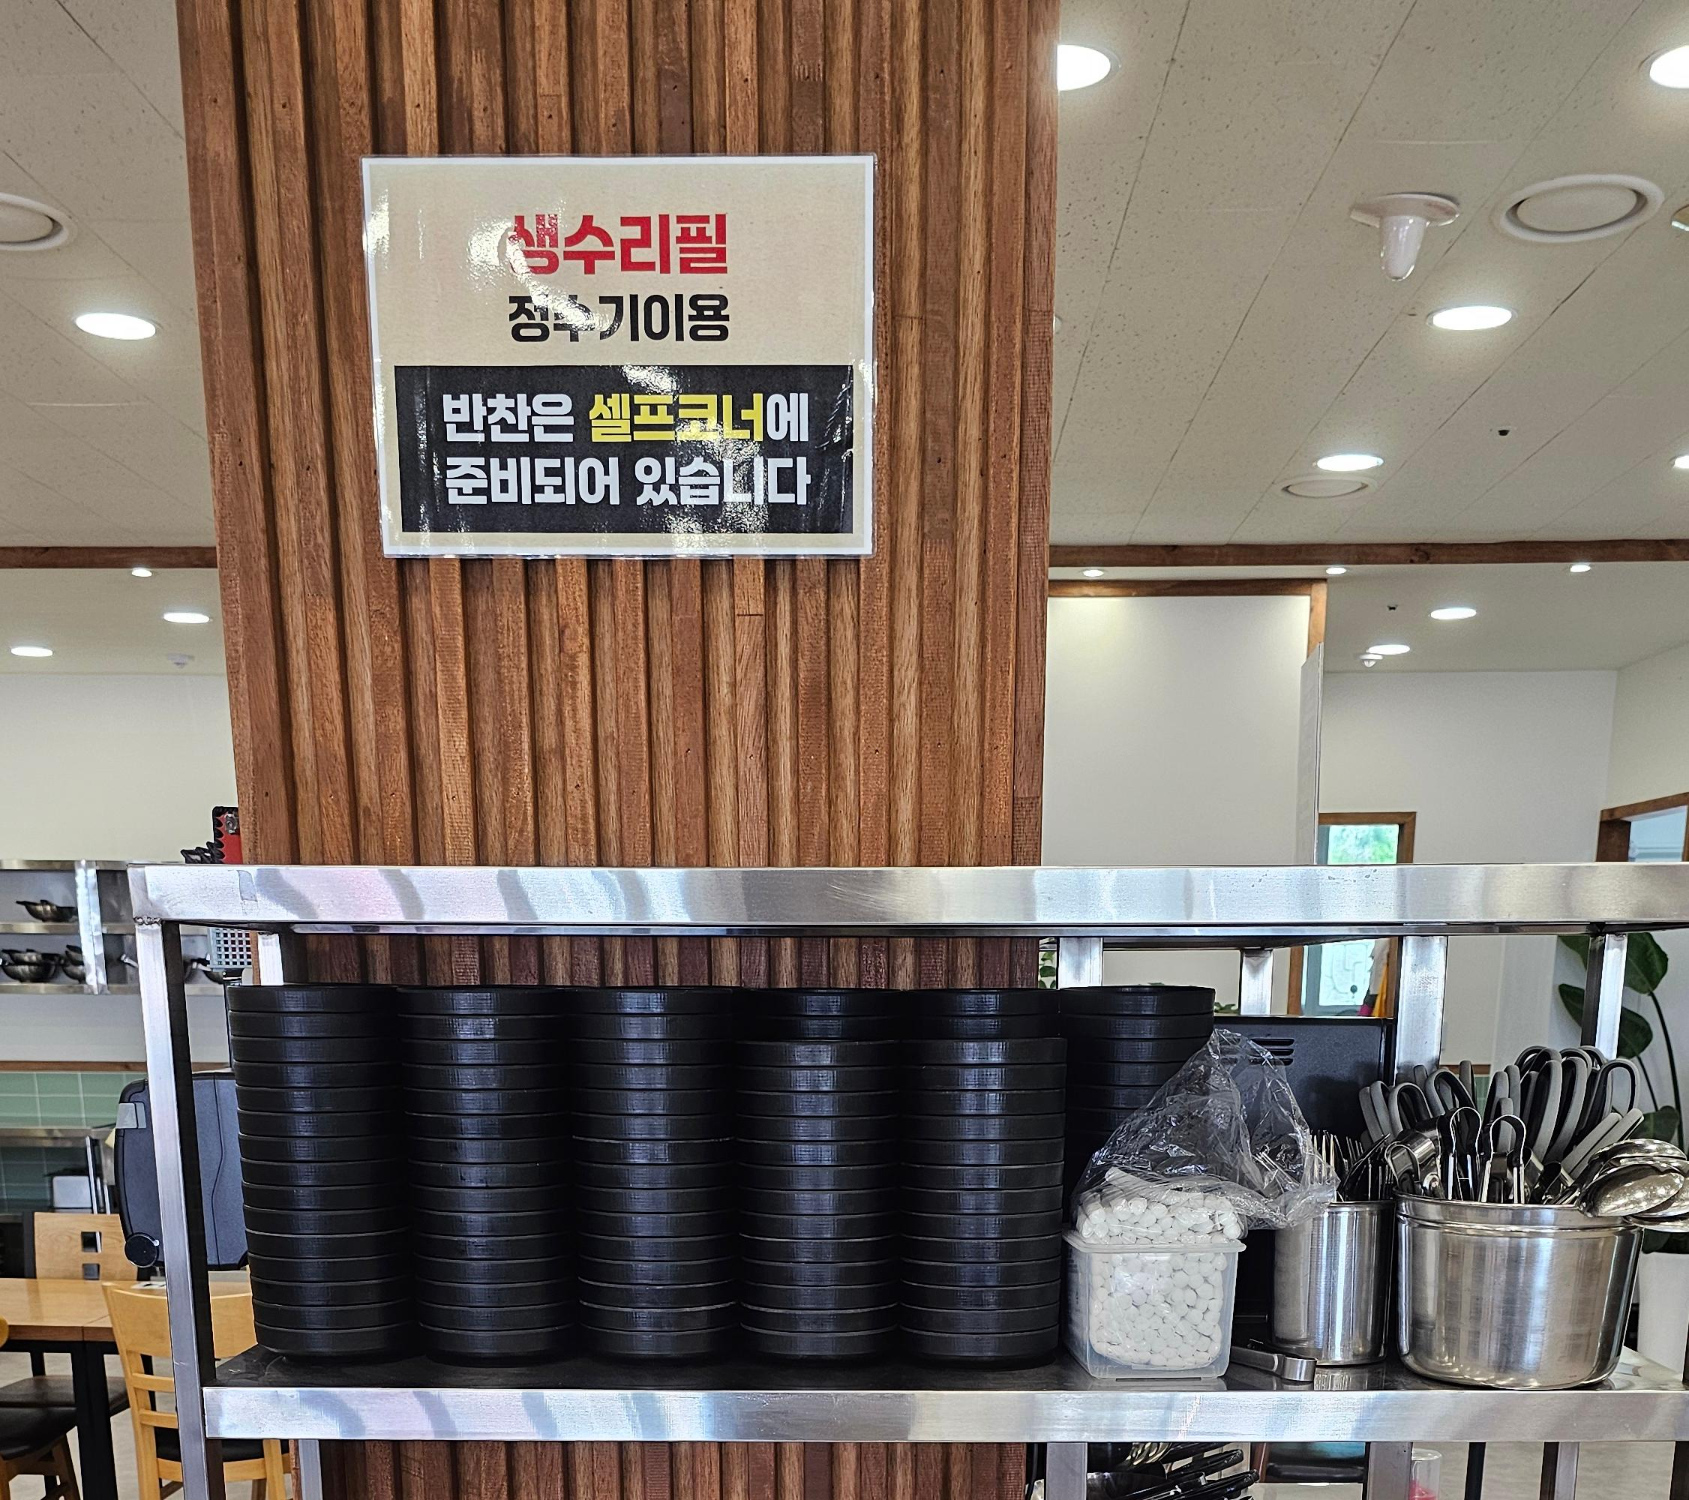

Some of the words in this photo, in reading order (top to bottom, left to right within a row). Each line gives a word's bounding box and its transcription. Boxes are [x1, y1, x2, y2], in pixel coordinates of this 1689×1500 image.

[508, 213, 729, 275] 생수리필
[508, 293, 730, 343] 정수기이용
[442, 393, 574, 443] 반찬은
[588, 393, 809, 443] 셀프코너에
[445, 456, 621, 507] 준비되어
[635, 456, 812, 507] 있습니다
